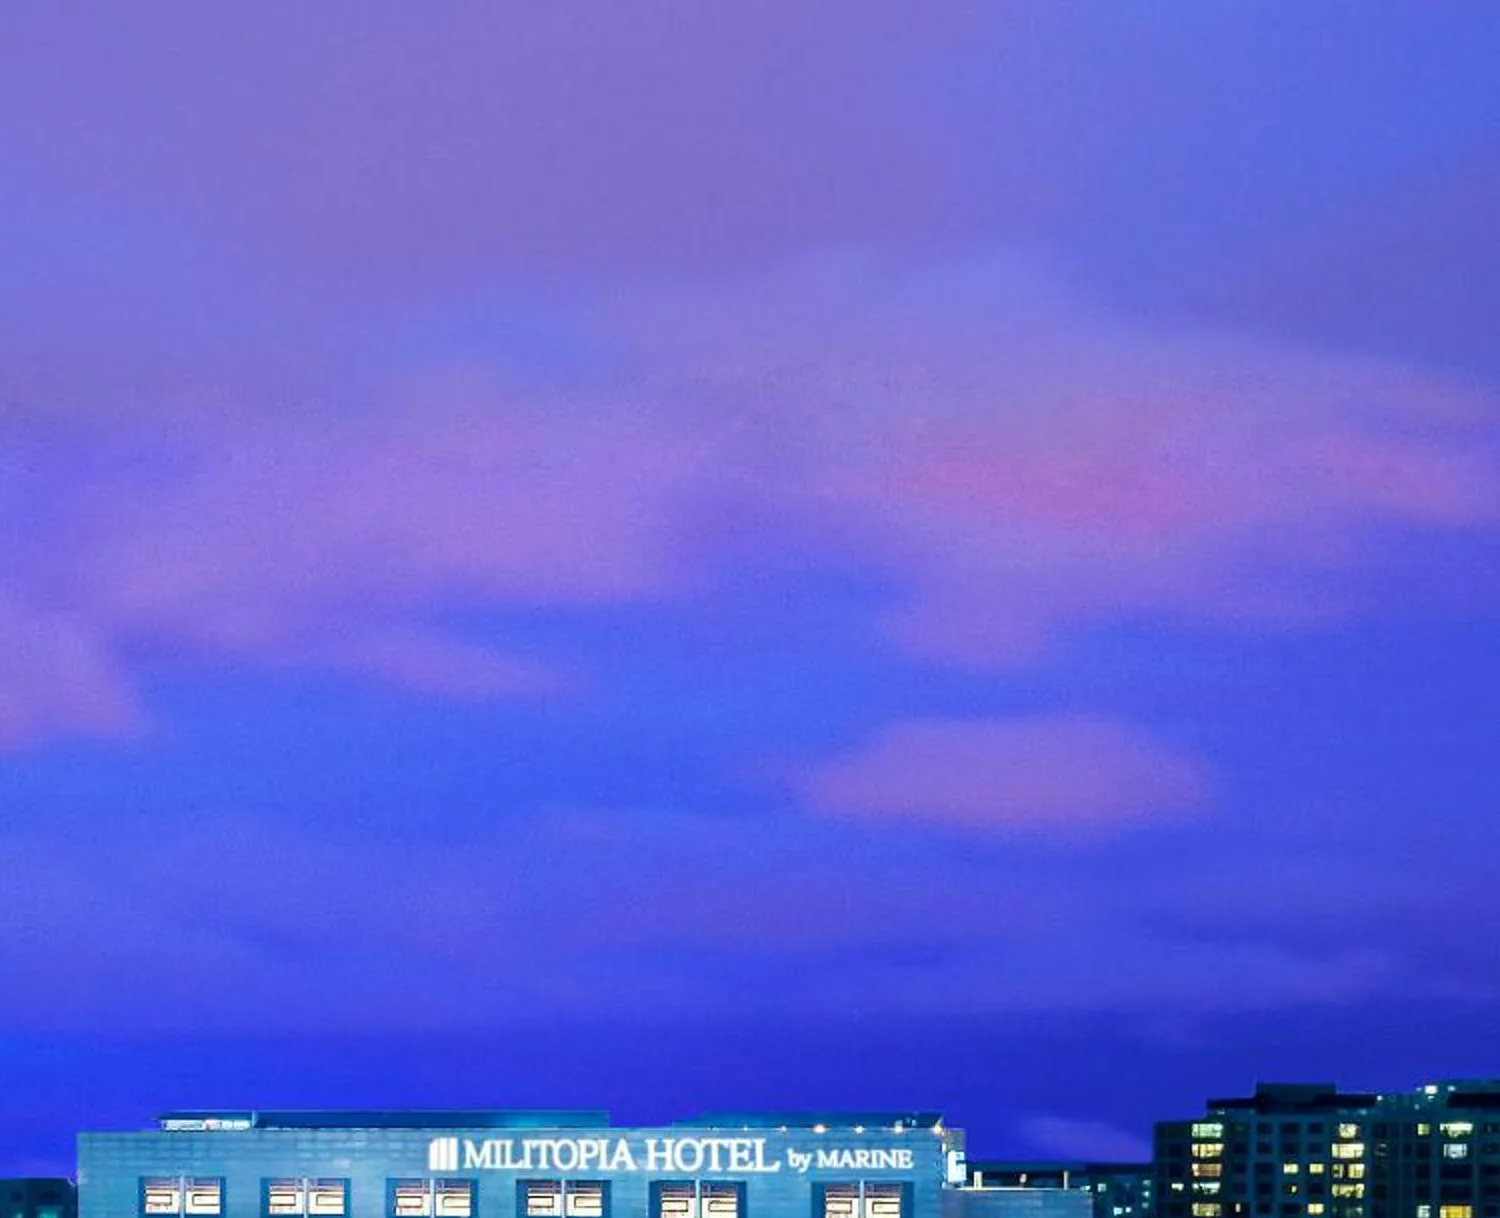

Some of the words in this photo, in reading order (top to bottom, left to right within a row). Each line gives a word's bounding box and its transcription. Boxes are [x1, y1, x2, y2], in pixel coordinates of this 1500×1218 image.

[463, 1137, 637, 1171] MILITOPIA
[644, 1138, 780, 1172] HOTEL
[788, 1148, 812, 1172] by
[816, 1150, 914, 1169] MARINE
